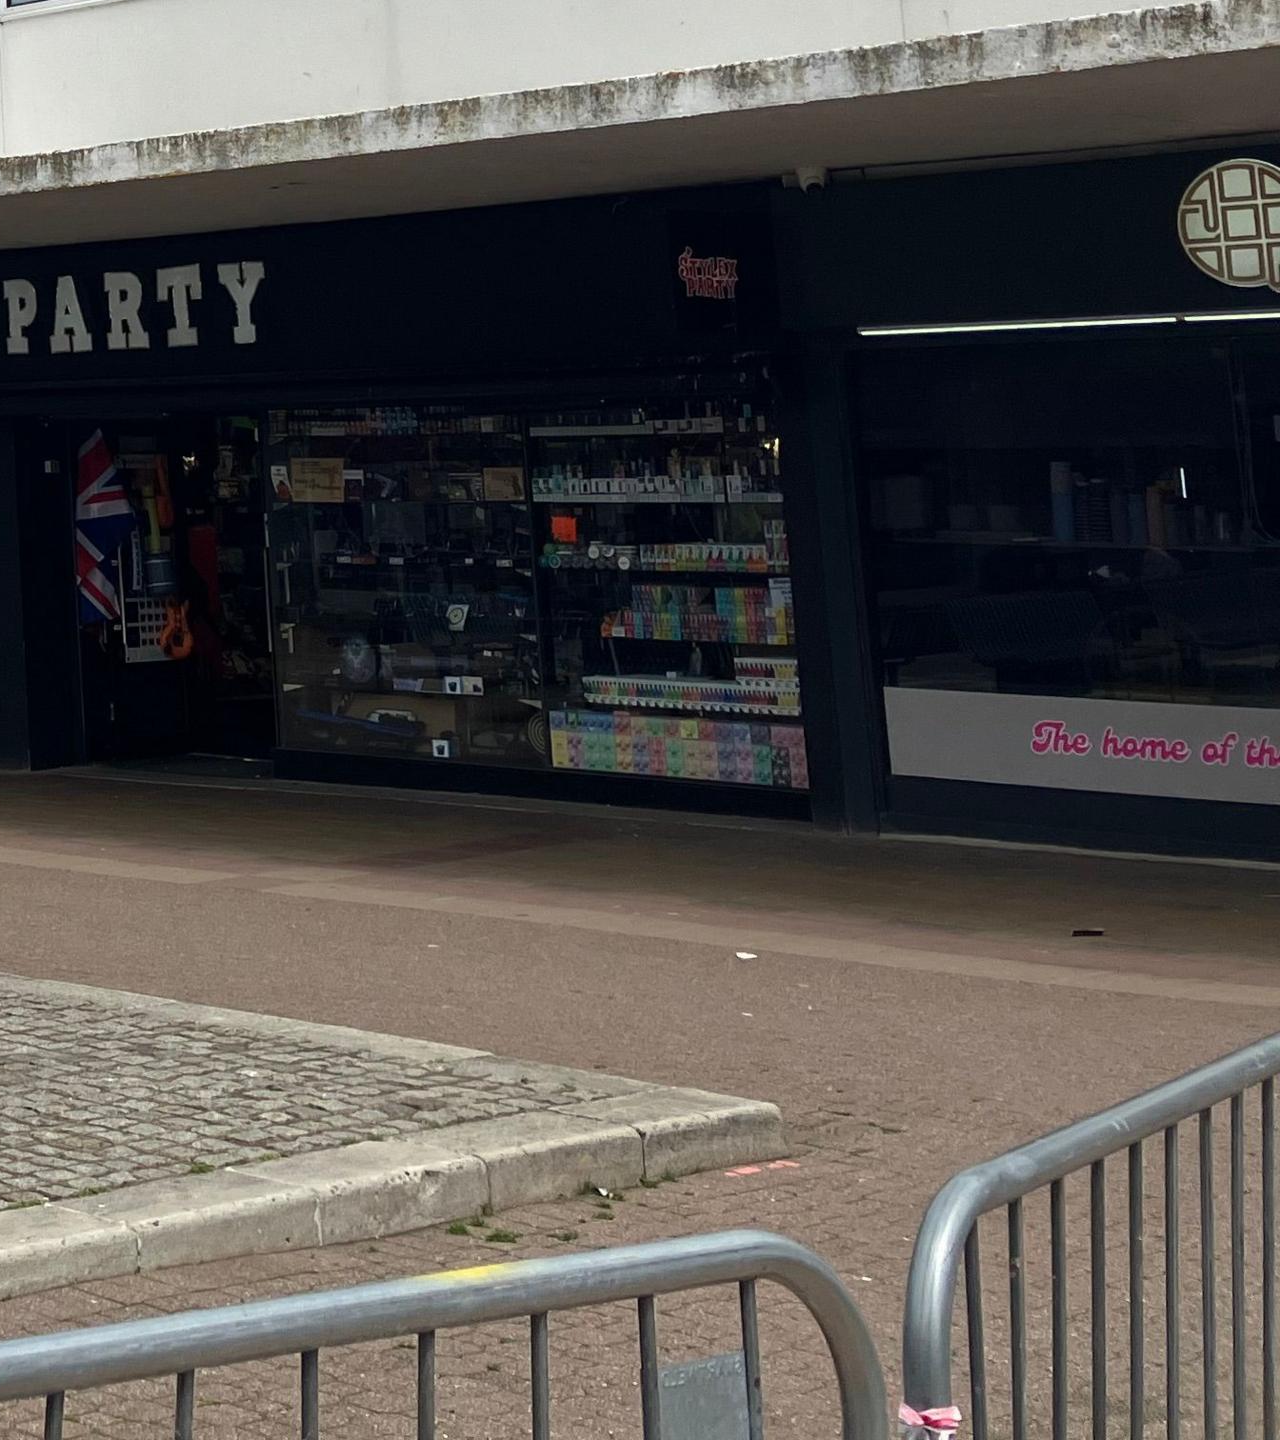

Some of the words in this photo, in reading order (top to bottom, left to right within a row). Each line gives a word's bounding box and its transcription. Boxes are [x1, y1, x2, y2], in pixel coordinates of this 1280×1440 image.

[679, 247, 738, 280] STYLEX
[3, 261, 266, 355] PARTY
[686, 277, 736, 299] PARTY
[1031, 719, 1092, 755] The
[1101, 726, 1191, 762] home
[1200, 731, 1240, 766] of
